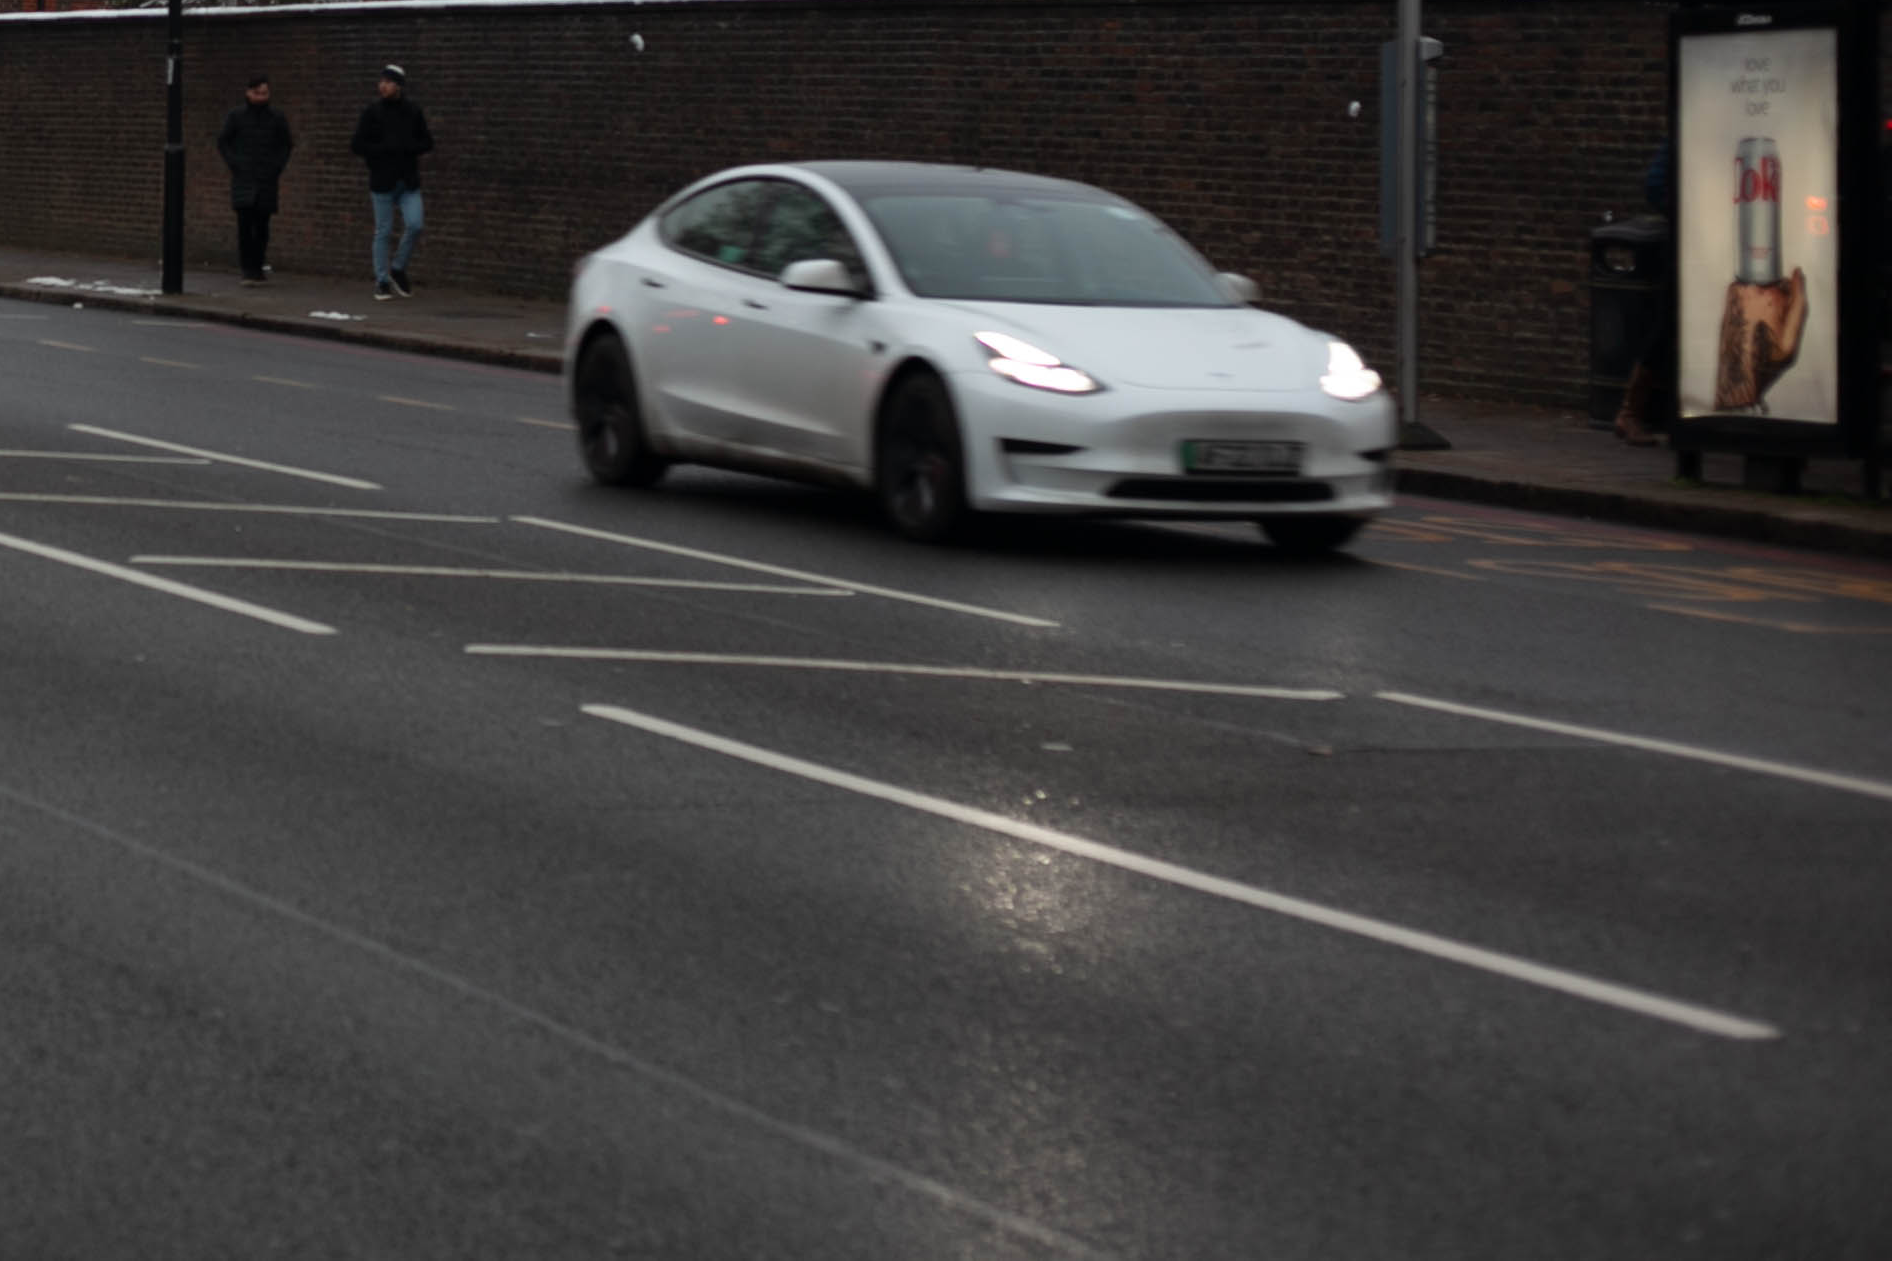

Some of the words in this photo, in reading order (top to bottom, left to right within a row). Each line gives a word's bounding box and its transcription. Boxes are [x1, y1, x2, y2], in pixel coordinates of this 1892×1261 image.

[1744, 56, 1772, 73] love
[1730, 77, 1762, 94] what
[1763, 80, 1786, 97] you
